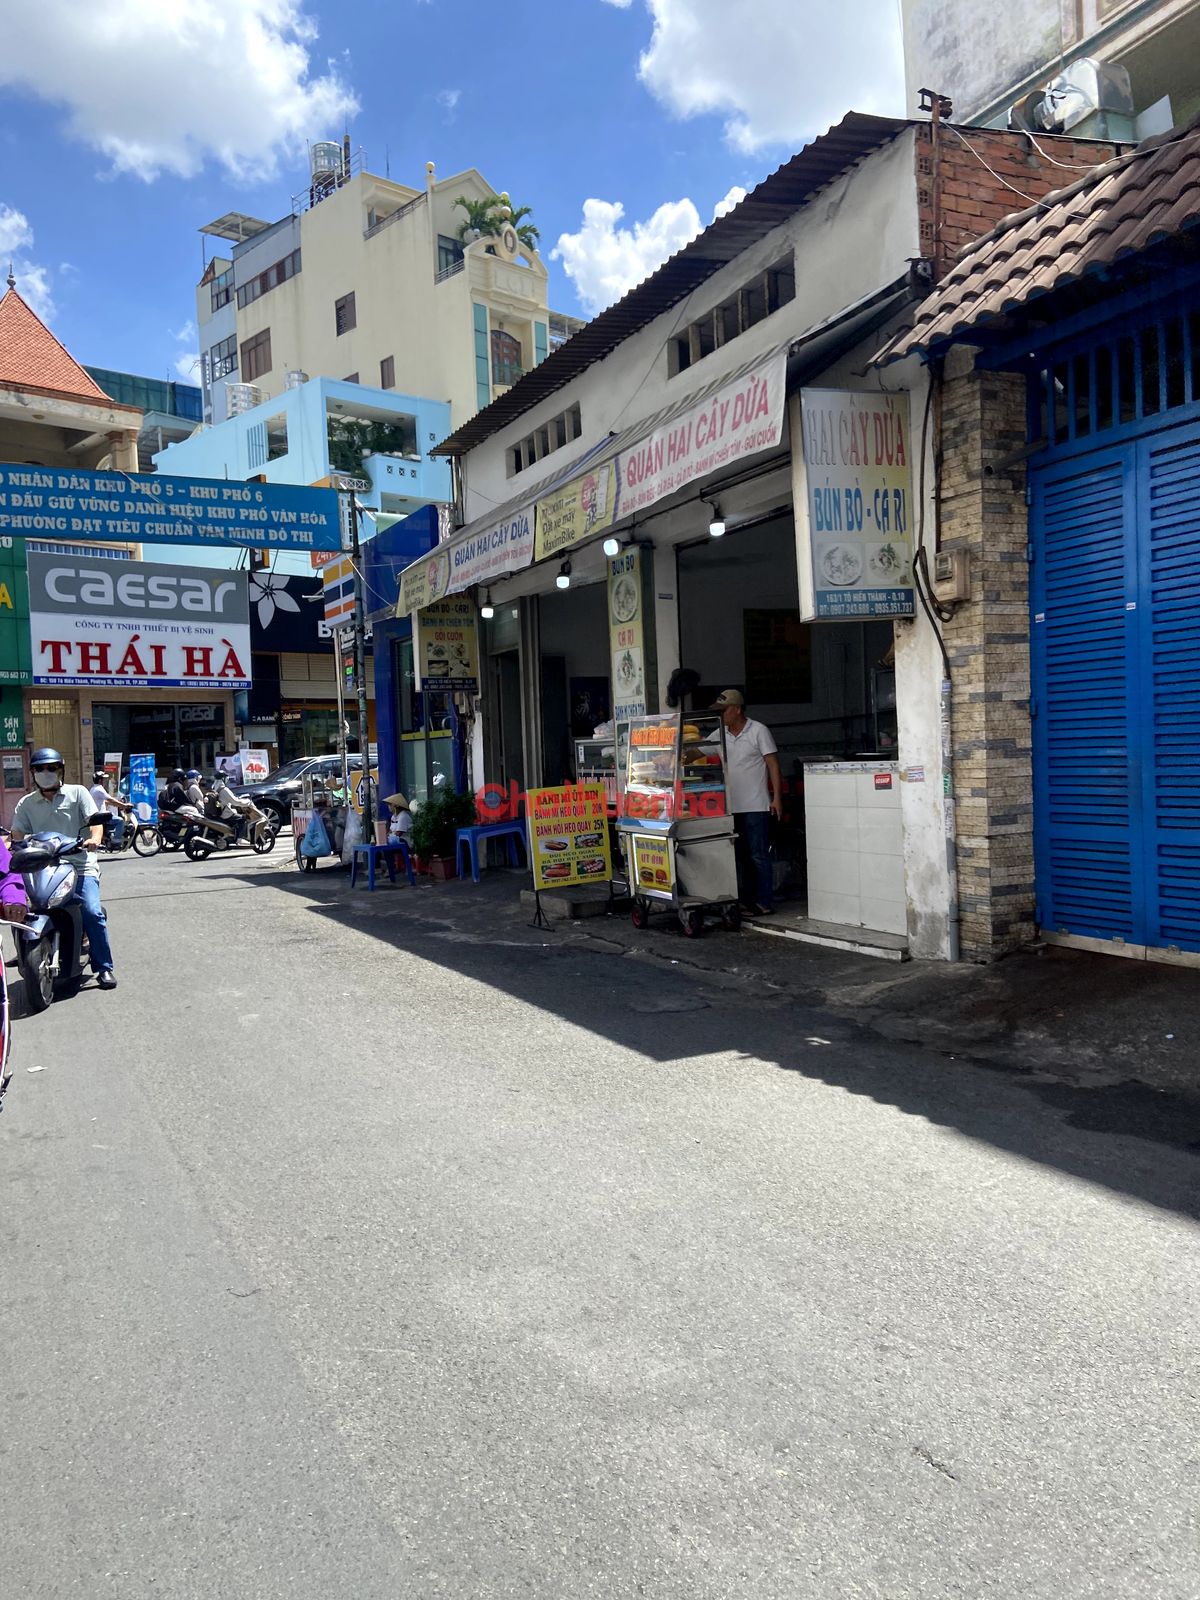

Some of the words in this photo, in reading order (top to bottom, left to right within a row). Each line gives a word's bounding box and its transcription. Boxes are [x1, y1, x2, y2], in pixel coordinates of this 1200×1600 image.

[627, 434, 664, 488] QUÁN
[667, 421, 692, 466] HAI
[695, 397, 730, 449] CÂY
[731, 374, 768, 430] DỪA
[807, 409, 837, 466] HAI
[839, 394, 869, 466] CÂY
[873, 395, 906, 466] DỪA
[8, 472, 53, 488] NHÂN
[58, 474, 90, 491] DÂN
[95, 479, 125, 492] KHU
[131, 480, 161, 495] PHỐ
[166, 485, 174, 496] 5
[190, 486, 218, 499] KHU
[222, 486, 251, 501] PHỐ
[255, 491, 263, 502] 6
[11, 490, 43, 507] ĐẤU
[124, 502, 166, 515] DANH
[207, 506, 236, 520] KHU
[240, 506, 268, 521] PHỐ
[814, 477, 842, 532] BÚN
[845, 477, 863, 532] BÒ
[874, 477, 890, 535] CÀ
[894, 487, 907, 536] RI
[71, 518, 102, 534] ĐẠT
[106, 518, 140, 533] TIÊU
[228, 526, 265, 540] MINH
[268, 527, 287, 541] ĐÔ
[291, 530, 313, 545] THỊ
[477, 534, 491, 556] HAI
[75, 620, 101, 629] CÔNG
[116, 623, 140, 631] TNHH
[143, 623, 169, 632] THIẾT
[195, 627, 214, 635] SINH
[41, 634, 167, 675] THÁI
[182, 638, 246, 678] HÀ
[536, 822, 552, 836] BÁNH
[565, 822, 576, 834] HEO
[577, 821, 592, 832] QUAY
[594, 819, 604, 830] 25K
